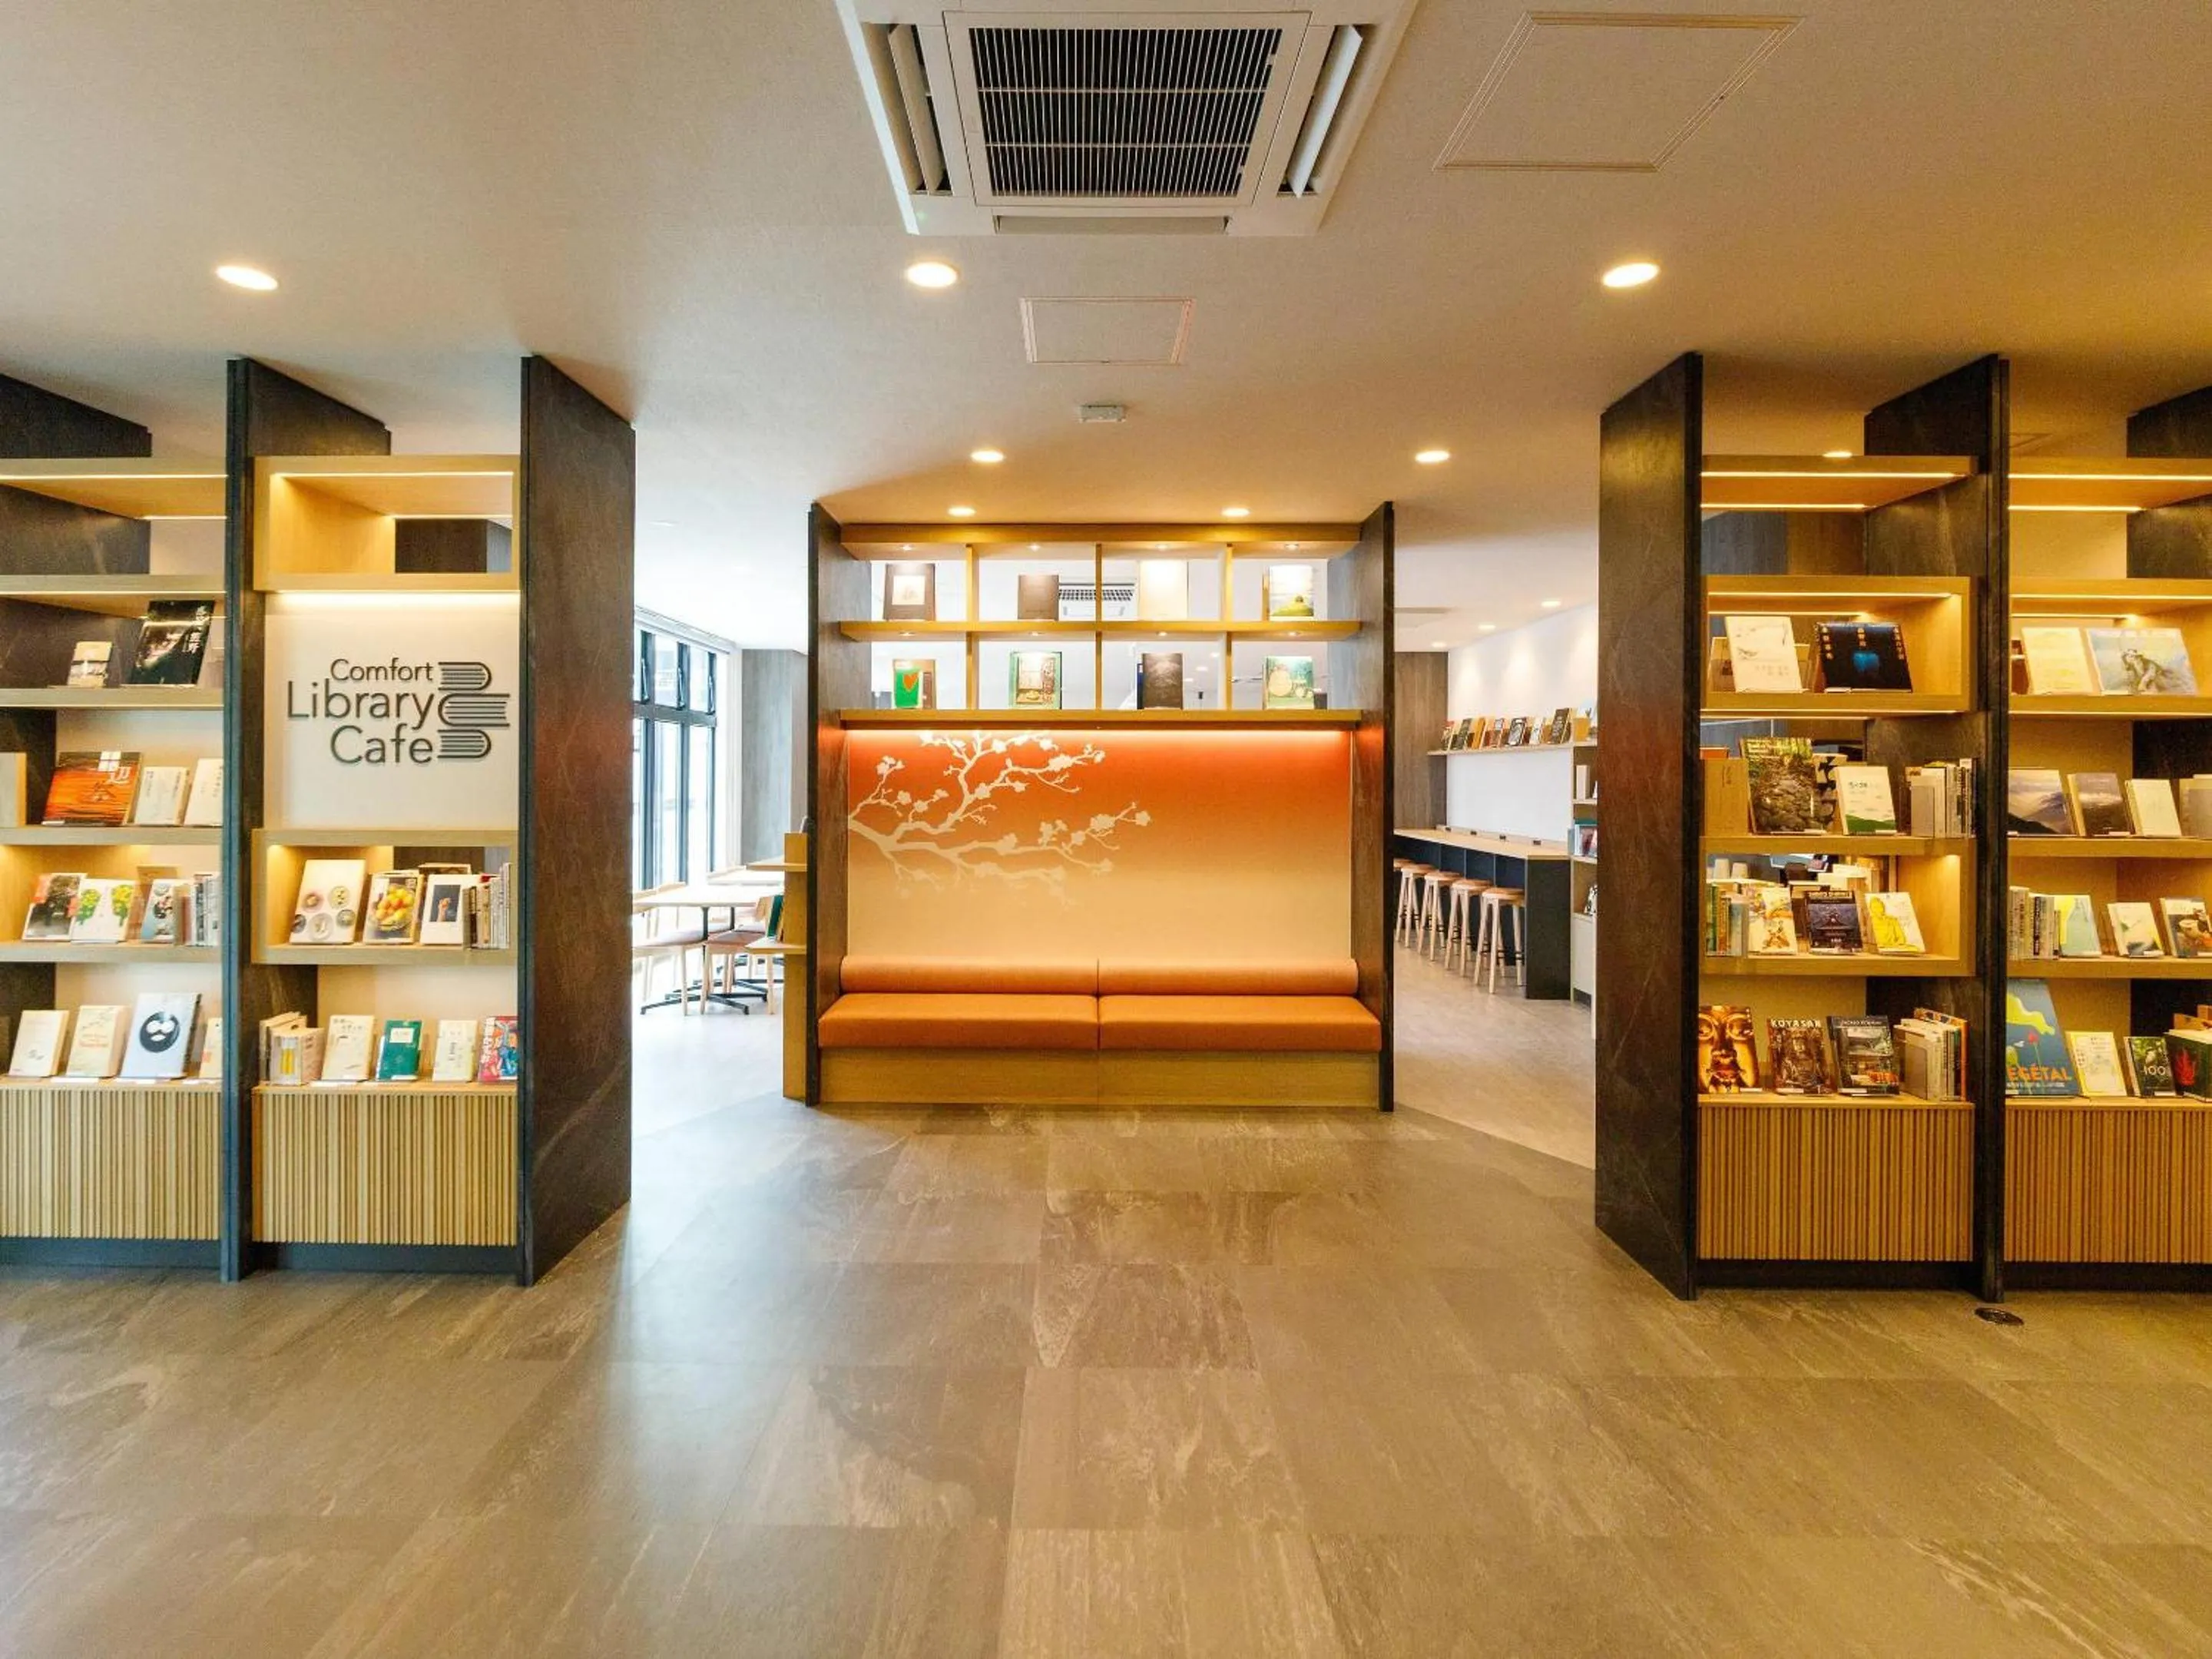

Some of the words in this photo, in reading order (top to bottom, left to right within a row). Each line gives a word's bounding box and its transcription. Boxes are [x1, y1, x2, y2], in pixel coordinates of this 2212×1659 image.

[330, 657, 433, 682] Comfort
[288, 678, 435, 730] Library
[330, 723, 433, 764] Cafe
